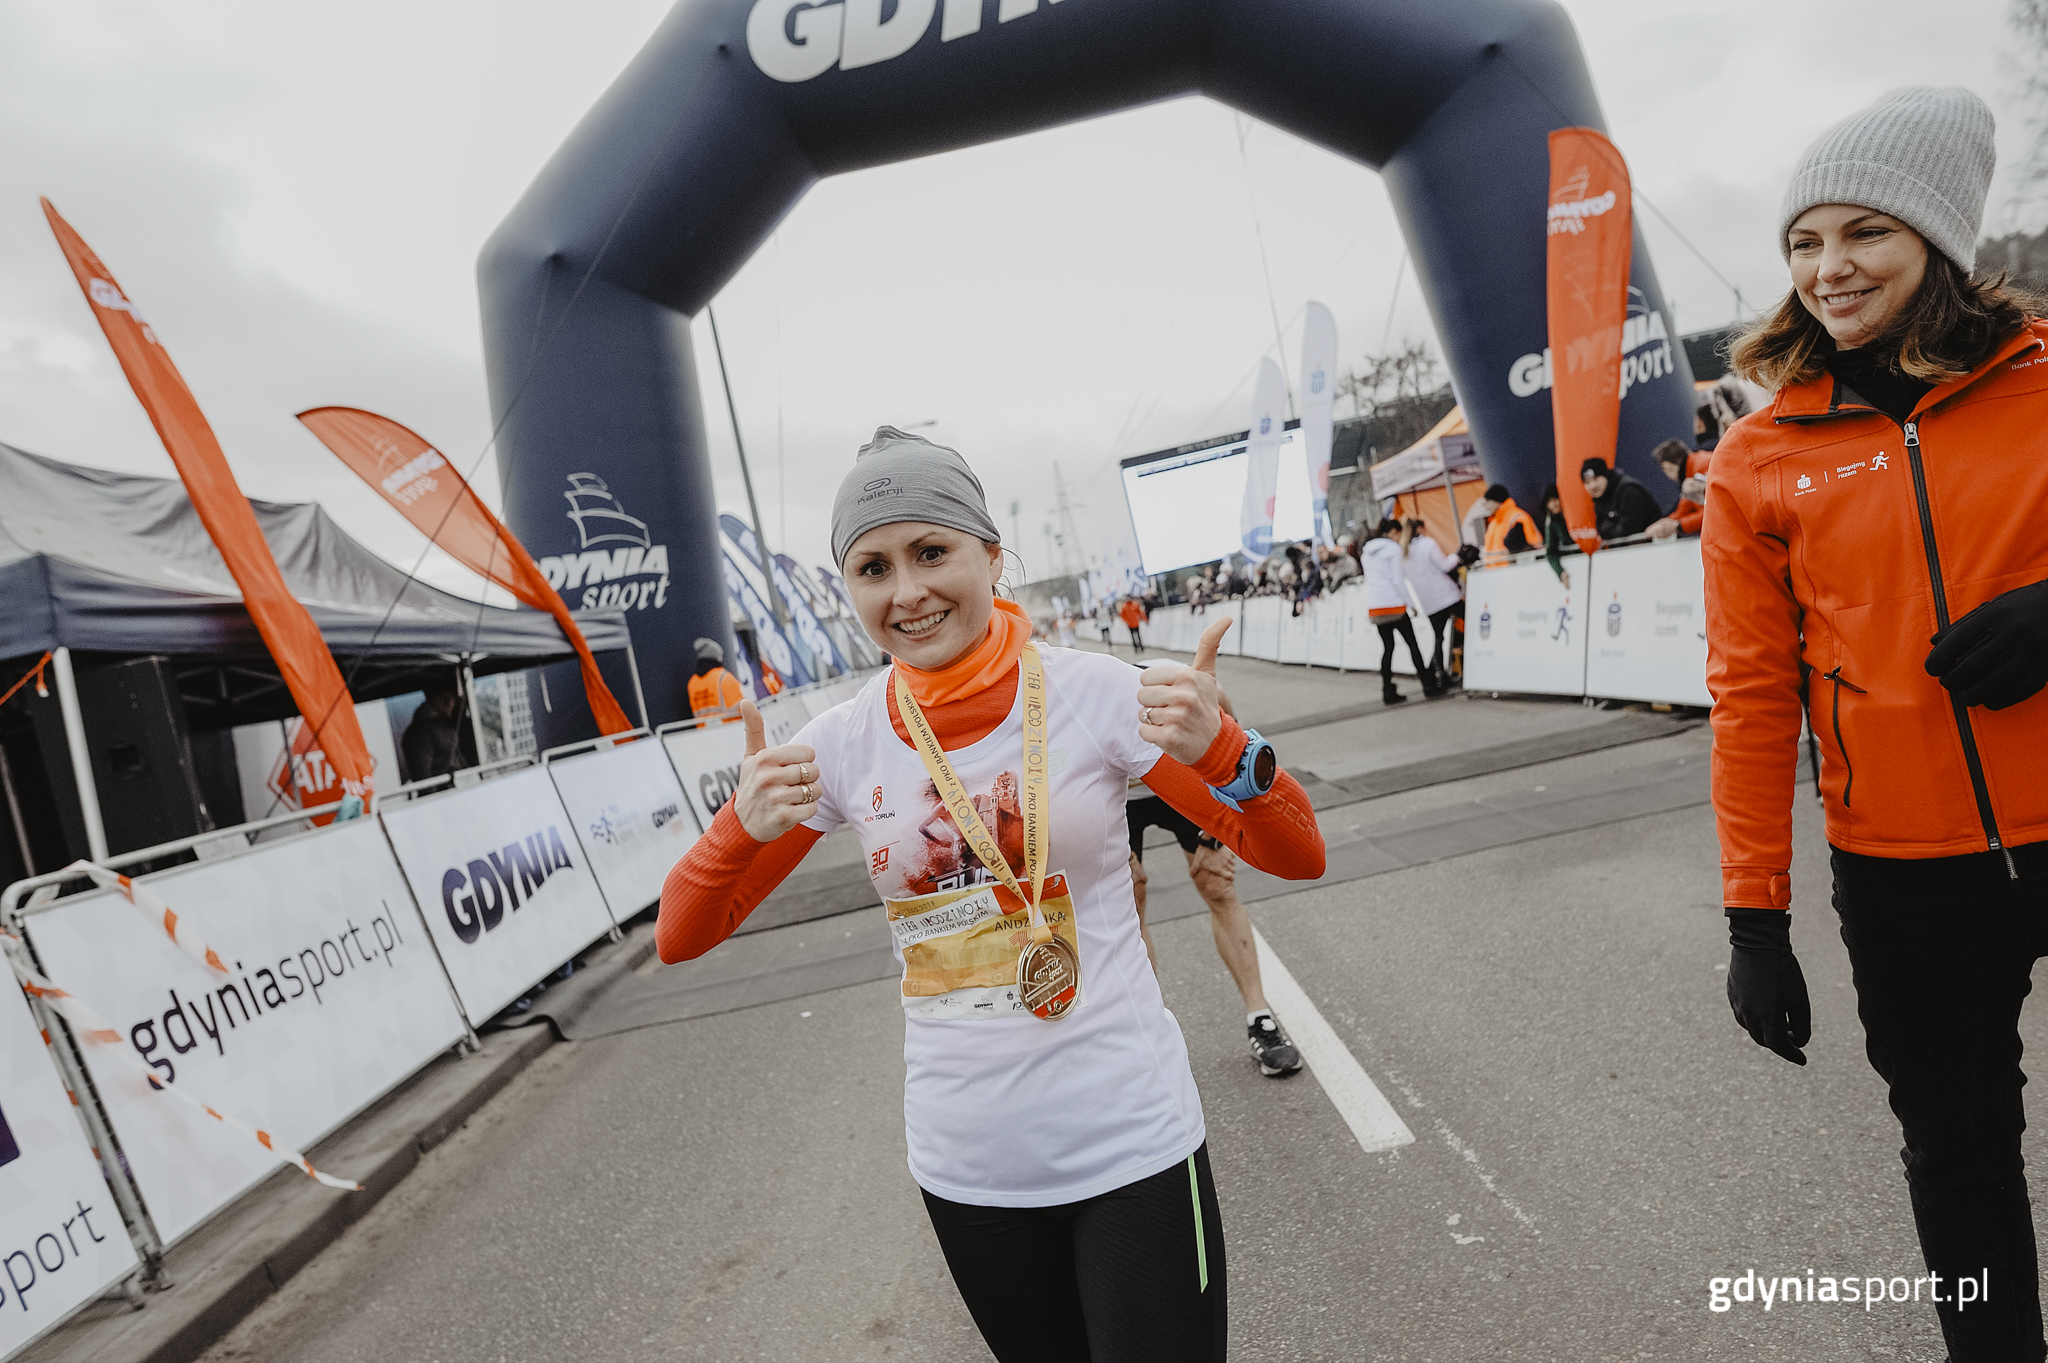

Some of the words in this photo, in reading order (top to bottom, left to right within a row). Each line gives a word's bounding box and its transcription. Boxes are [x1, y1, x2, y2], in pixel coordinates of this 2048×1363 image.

[1837, 470, 1858, 479] razem
[857, 486, 903, 506] Kalenji
[533, 544, 670, 593] DYNIA
[903, 693, 924, 728] POLSKIM
[920, 727, 944, 765] BANKIEM
[939, 764, 953, 782] PKO
[1028, 792, 1037, 810] PKO
[1028, 811, 1037, 857] BANKIEM
[442, 825, 575, 945] GDYNIA
[924, 922, 956, 937] BANKIEM
[957, 910, 989, 928] POLSKIM
[994, 911, 1066, 931] ANDŻIKA
[131, 898, 404, 1090] gdyniasport.pl
[0, 1201, 105, 1312] port
